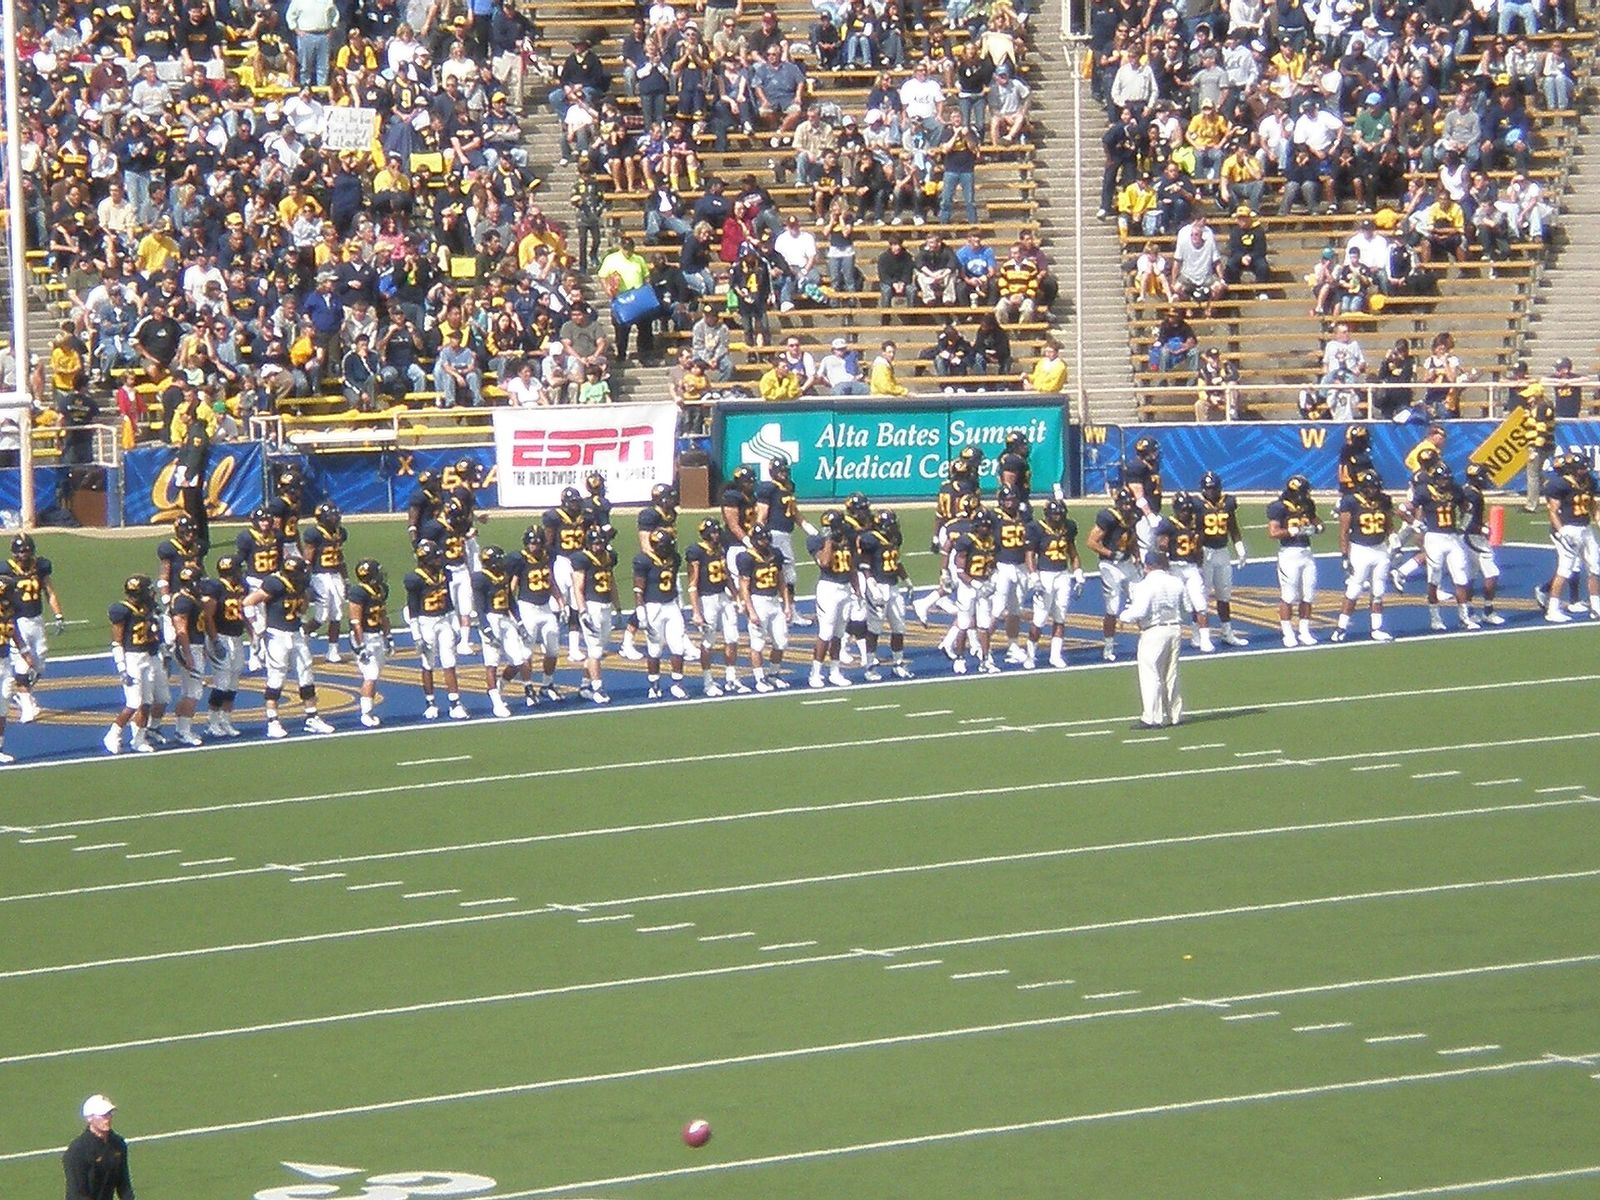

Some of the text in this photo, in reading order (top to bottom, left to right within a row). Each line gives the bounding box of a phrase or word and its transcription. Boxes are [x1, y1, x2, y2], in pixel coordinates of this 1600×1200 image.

[512, 424, 654, 467] ESPN
[815, 422, 870, 448] Alta
[876, 422, 940, 447] Bates
[1300, 428, 1326, 448] W
[1484, 417, 1529, 477] NOIS
[815, 453, 1000, 480] Medical Ceer
